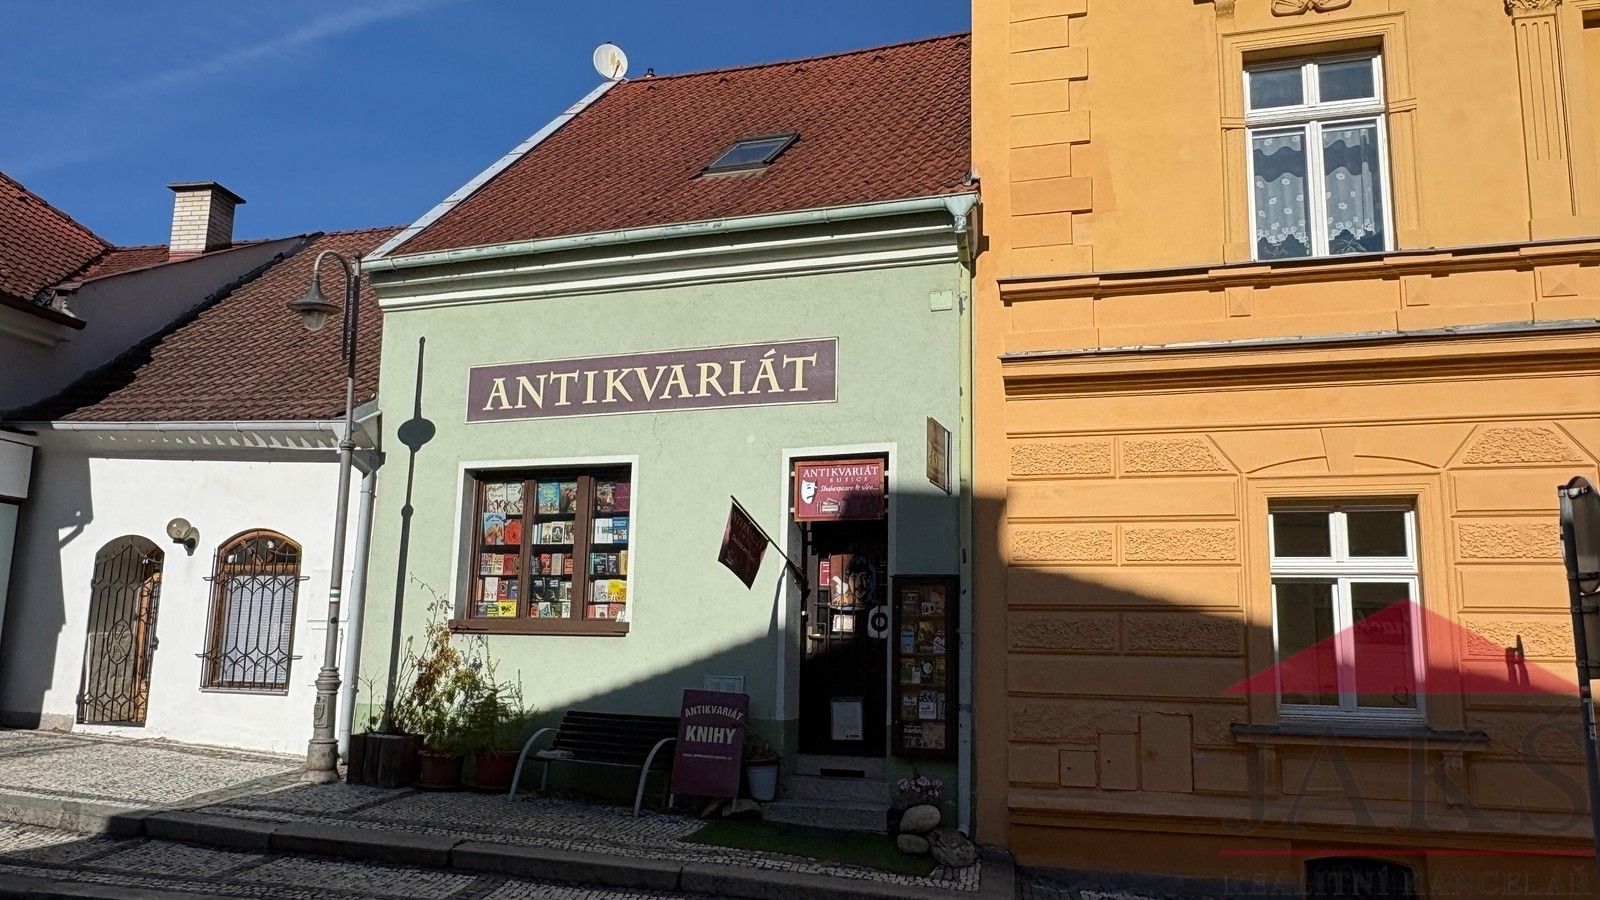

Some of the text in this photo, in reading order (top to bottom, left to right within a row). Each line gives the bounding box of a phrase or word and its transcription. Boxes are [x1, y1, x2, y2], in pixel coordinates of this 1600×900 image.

[482, 348, 817, 411] ANTIKVARIÁT
[803, 465, 879, 478] ANTIKVARIÁT
[685, 705, 743, 720] ANTIKVARIÁT
[685, 725, 736, 744] KNIHY
